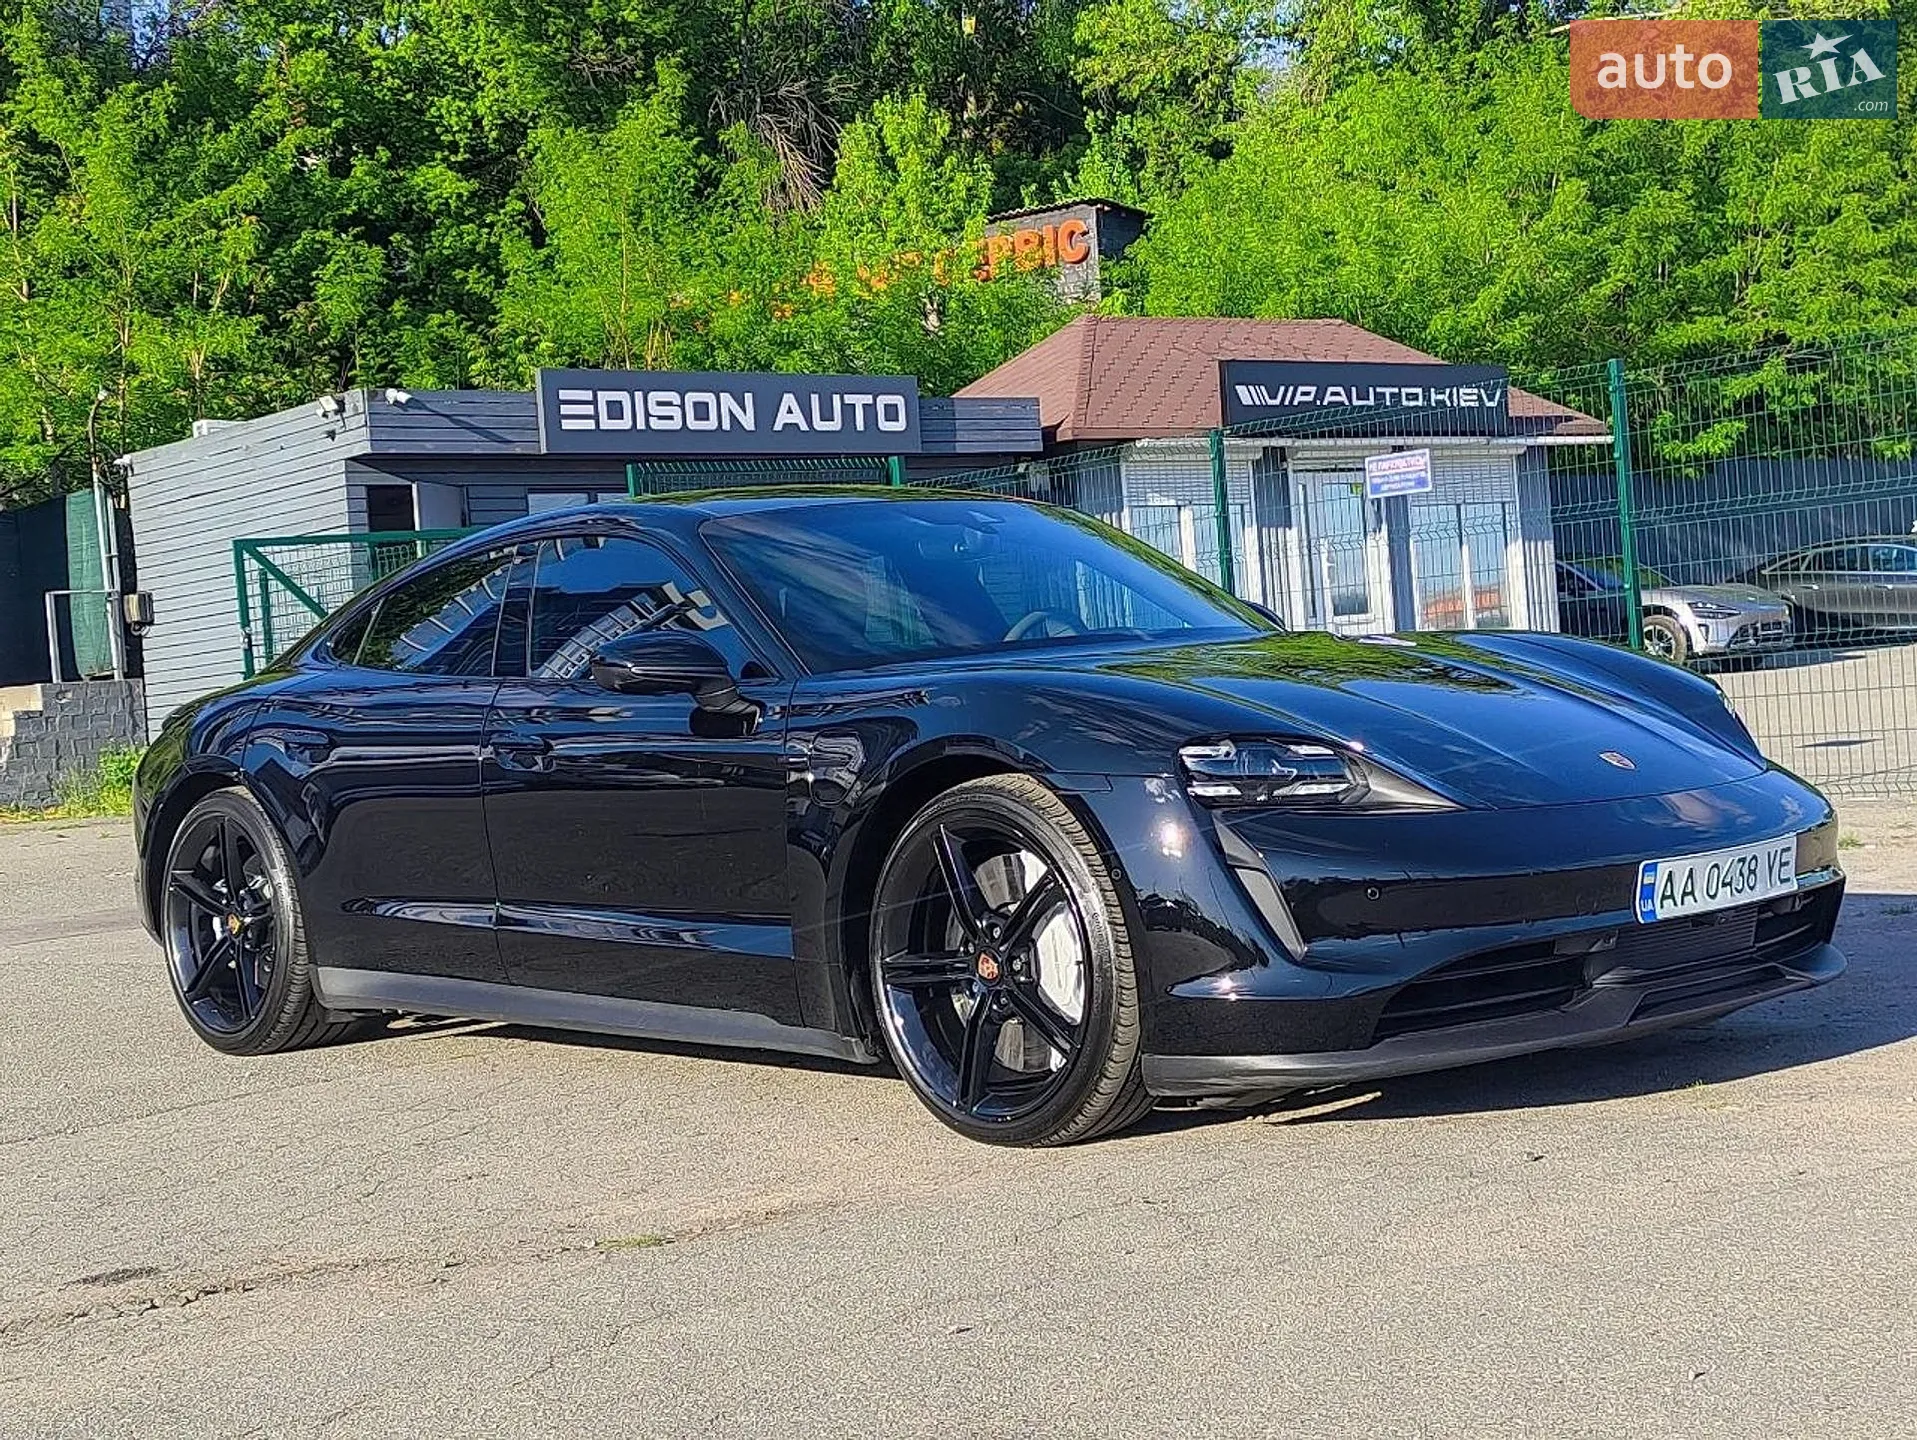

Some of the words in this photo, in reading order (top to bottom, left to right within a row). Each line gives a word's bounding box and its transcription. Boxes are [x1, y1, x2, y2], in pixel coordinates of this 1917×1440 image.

[558, 389, 756, 431] EDISON
[773, 393, 907, 432] AUTO
[1660, 867, 1697, 909] AA
[1706, 855, 1758, 899] 0438
[1767, 846, 1791, 888] YE
[1641, 899, 1654, 911] UA
